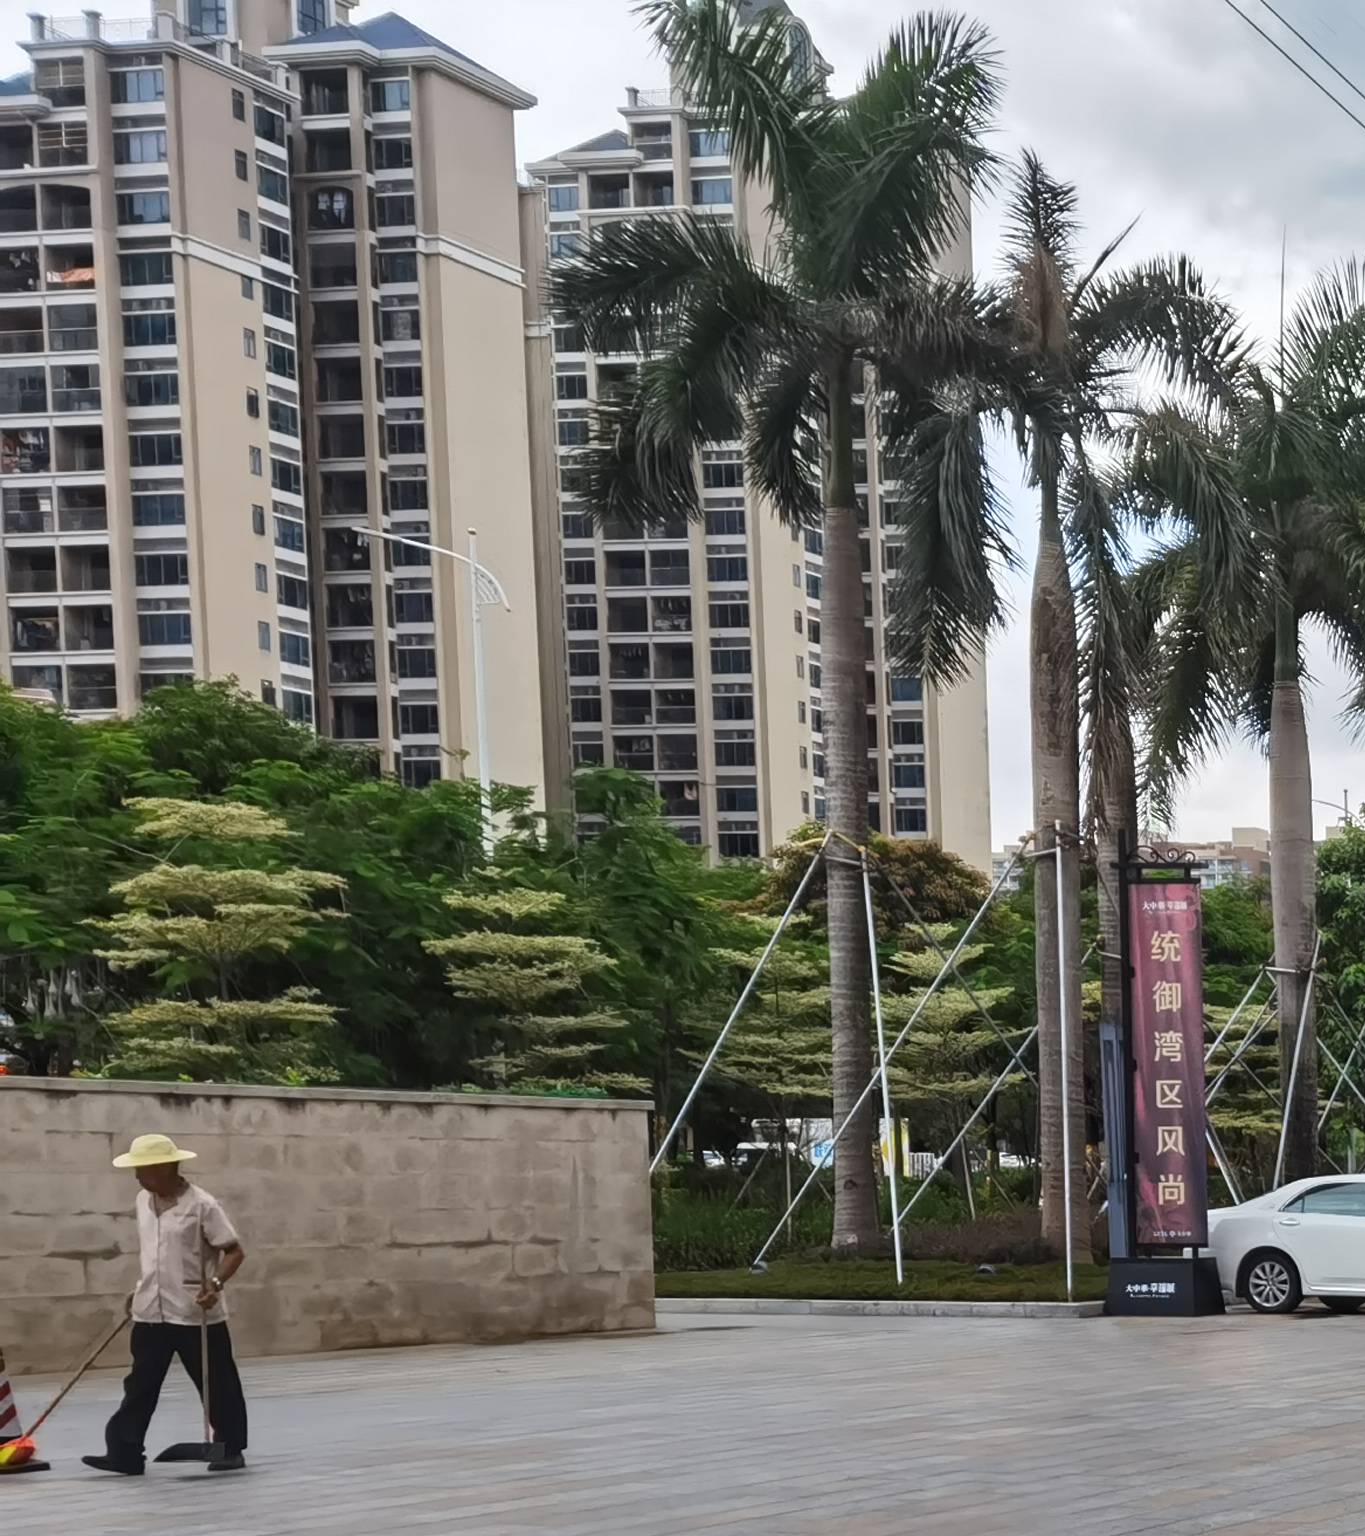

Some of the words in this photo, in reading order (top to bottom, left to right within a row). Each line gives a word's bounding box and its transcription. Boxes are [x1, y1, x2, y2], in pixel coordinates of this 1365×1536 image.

[1150, 930, 1186, 1206] 统御湾区风尚
